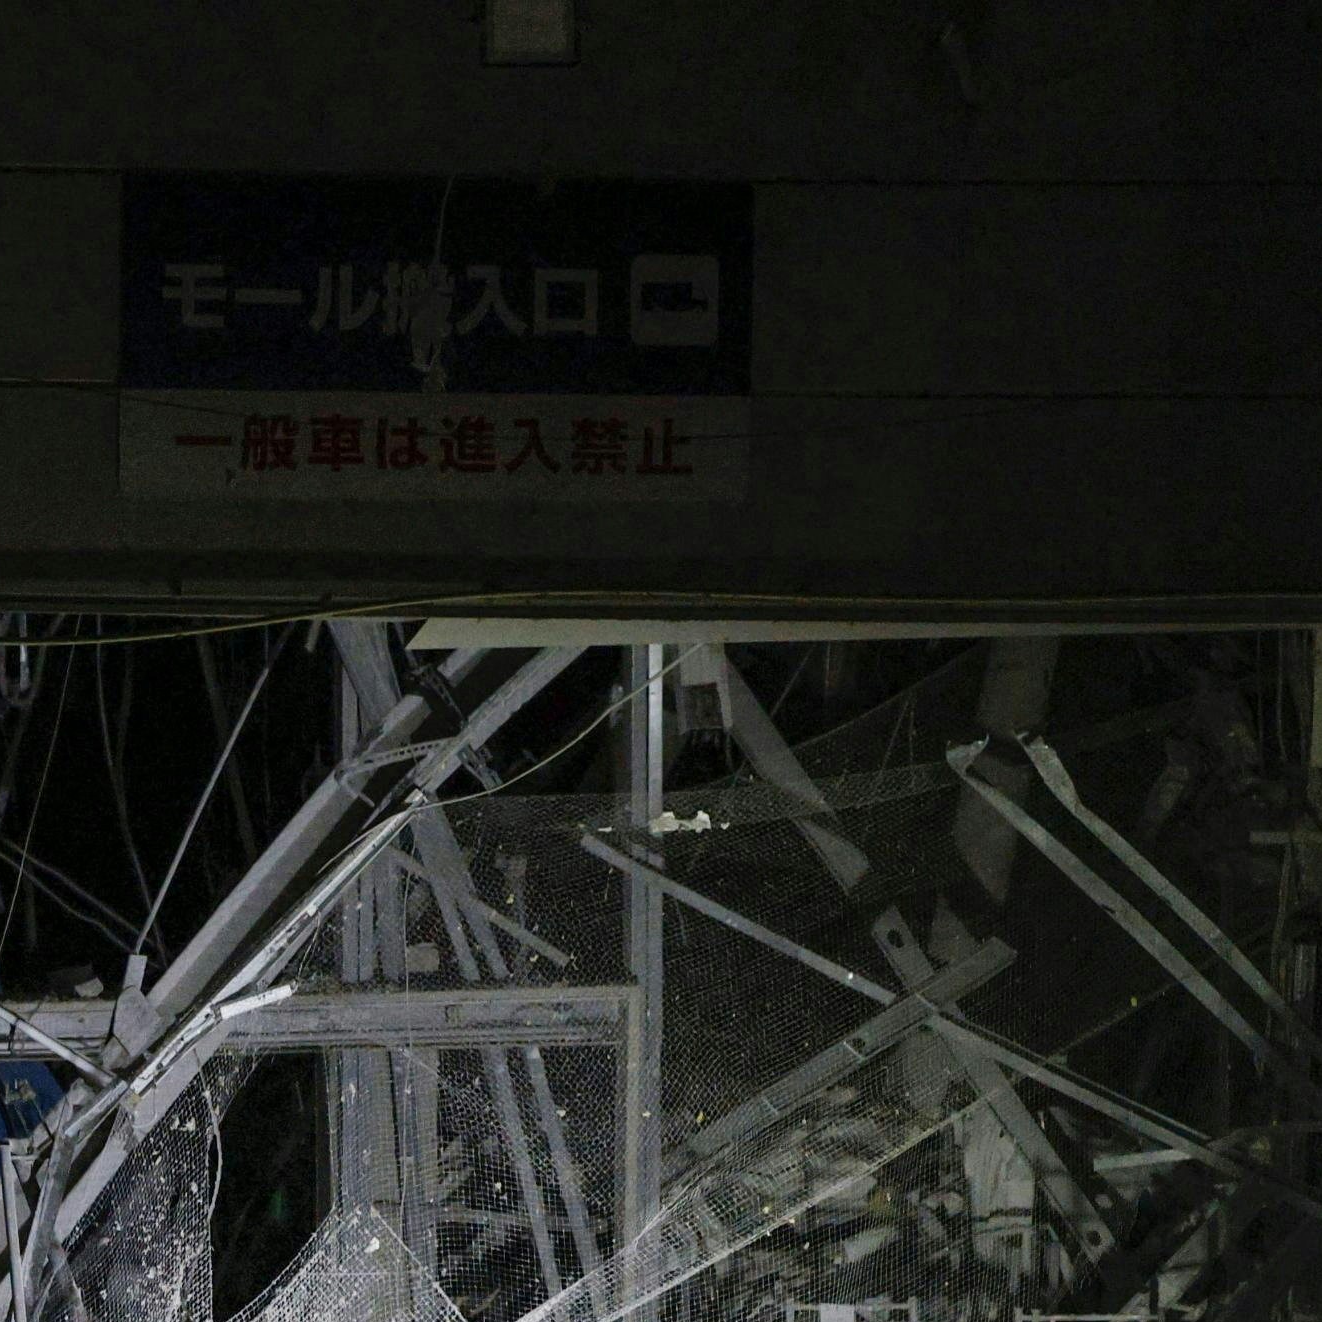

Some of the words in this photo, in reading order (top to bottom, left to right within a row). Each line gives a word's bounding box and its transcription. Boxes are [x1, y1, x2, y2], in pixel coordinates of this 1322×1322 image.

[175, 414, 694, 476] 一般車は進入禁止
